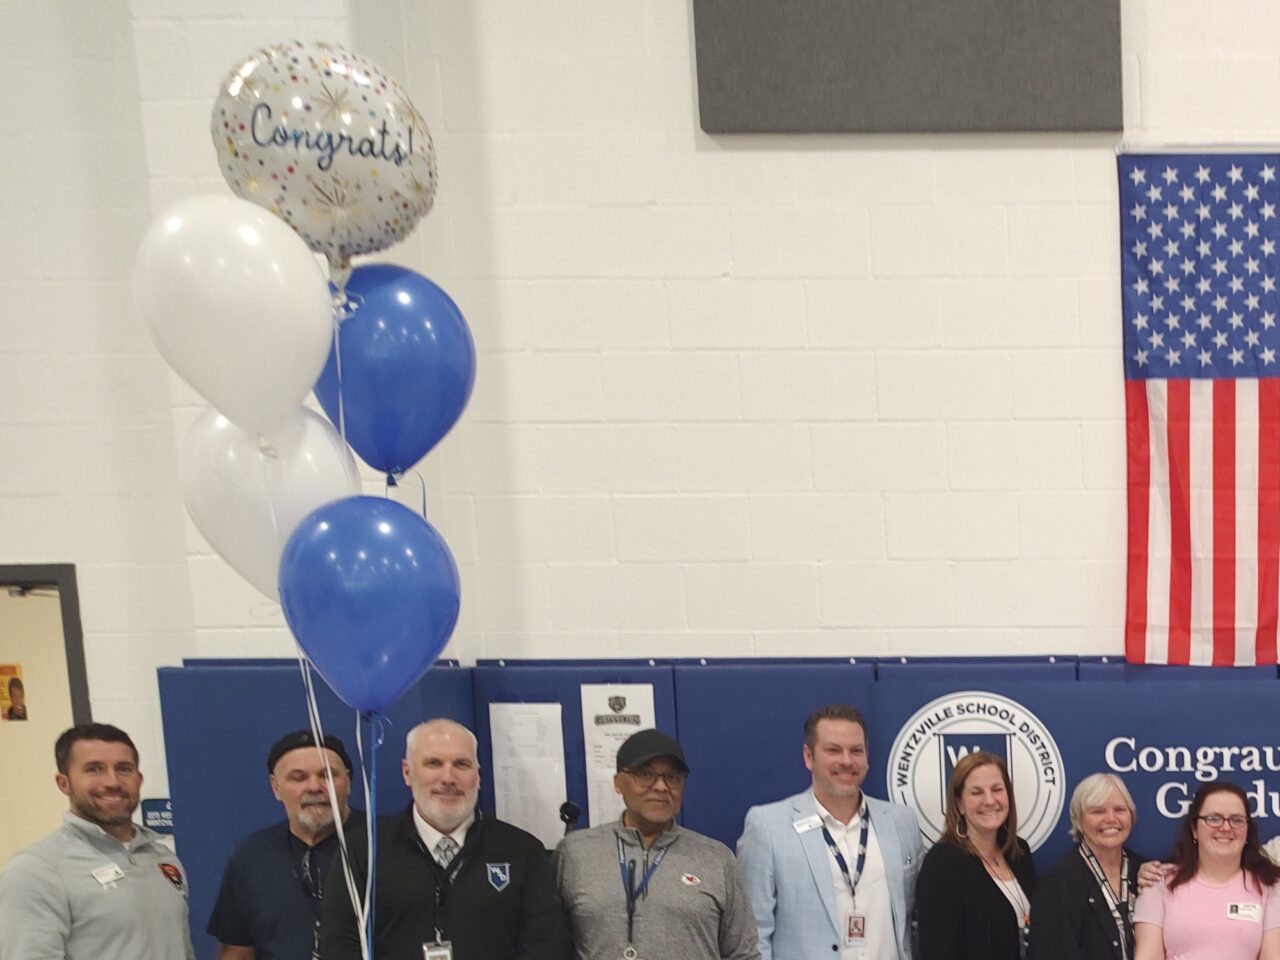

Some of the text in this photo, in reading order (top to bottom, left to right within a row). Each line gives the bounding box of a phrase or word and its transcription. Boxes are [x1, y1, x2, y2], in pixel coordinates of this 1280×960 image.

[251, 103, 413, 171] Congrats!
[897, 703, 1056, 787] WENTZVILLE SCHOOL DISTRICT
